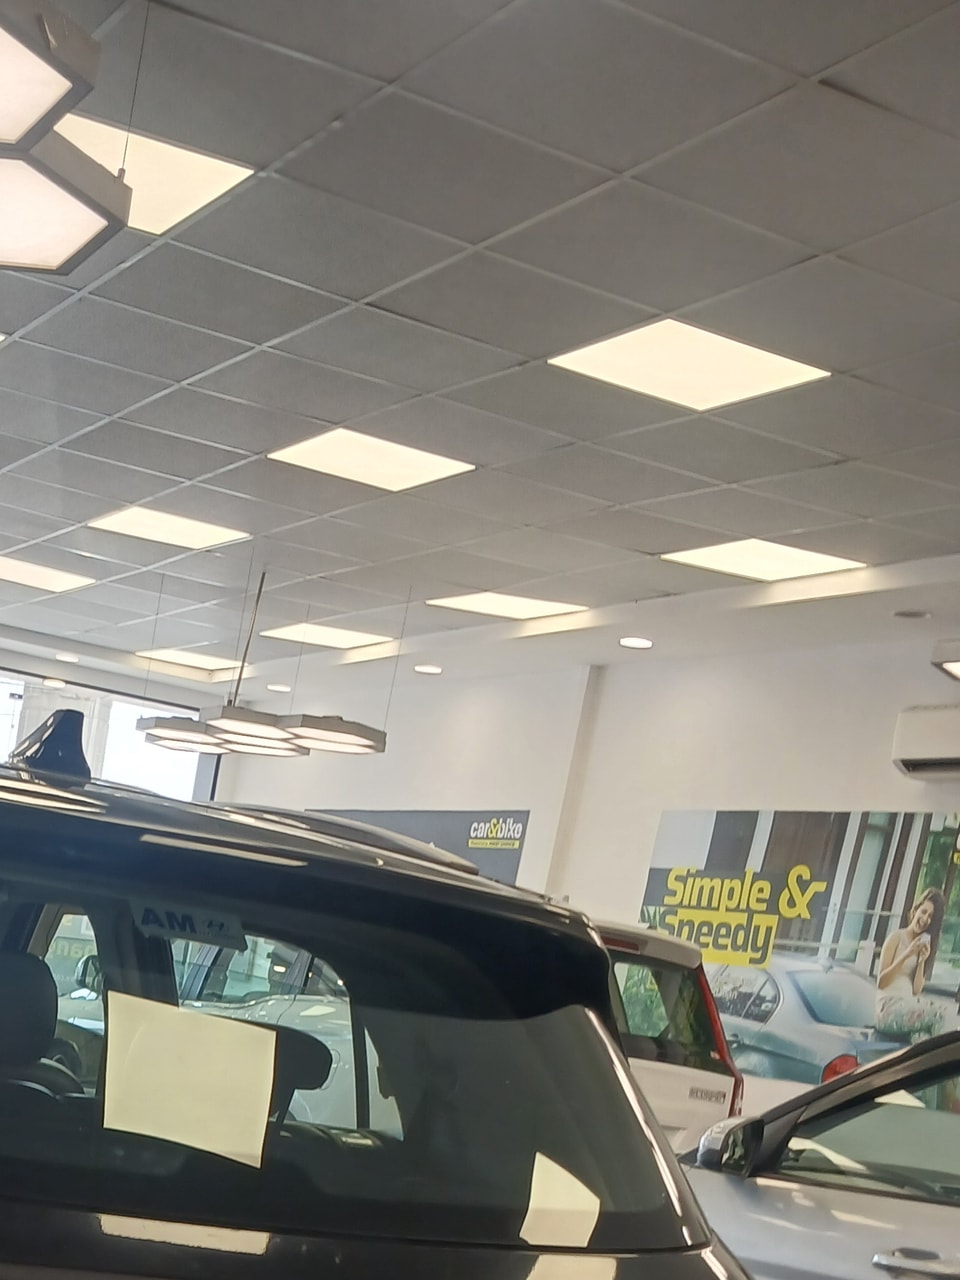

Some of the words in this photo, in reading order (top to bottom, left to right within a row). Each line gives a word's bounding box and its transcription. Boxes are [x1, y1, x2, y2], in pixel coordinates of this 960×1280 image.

[663, 867, 772, 913] Simple
[778, 864, 828, 920] &
[141, 907, 197, 934] AM
